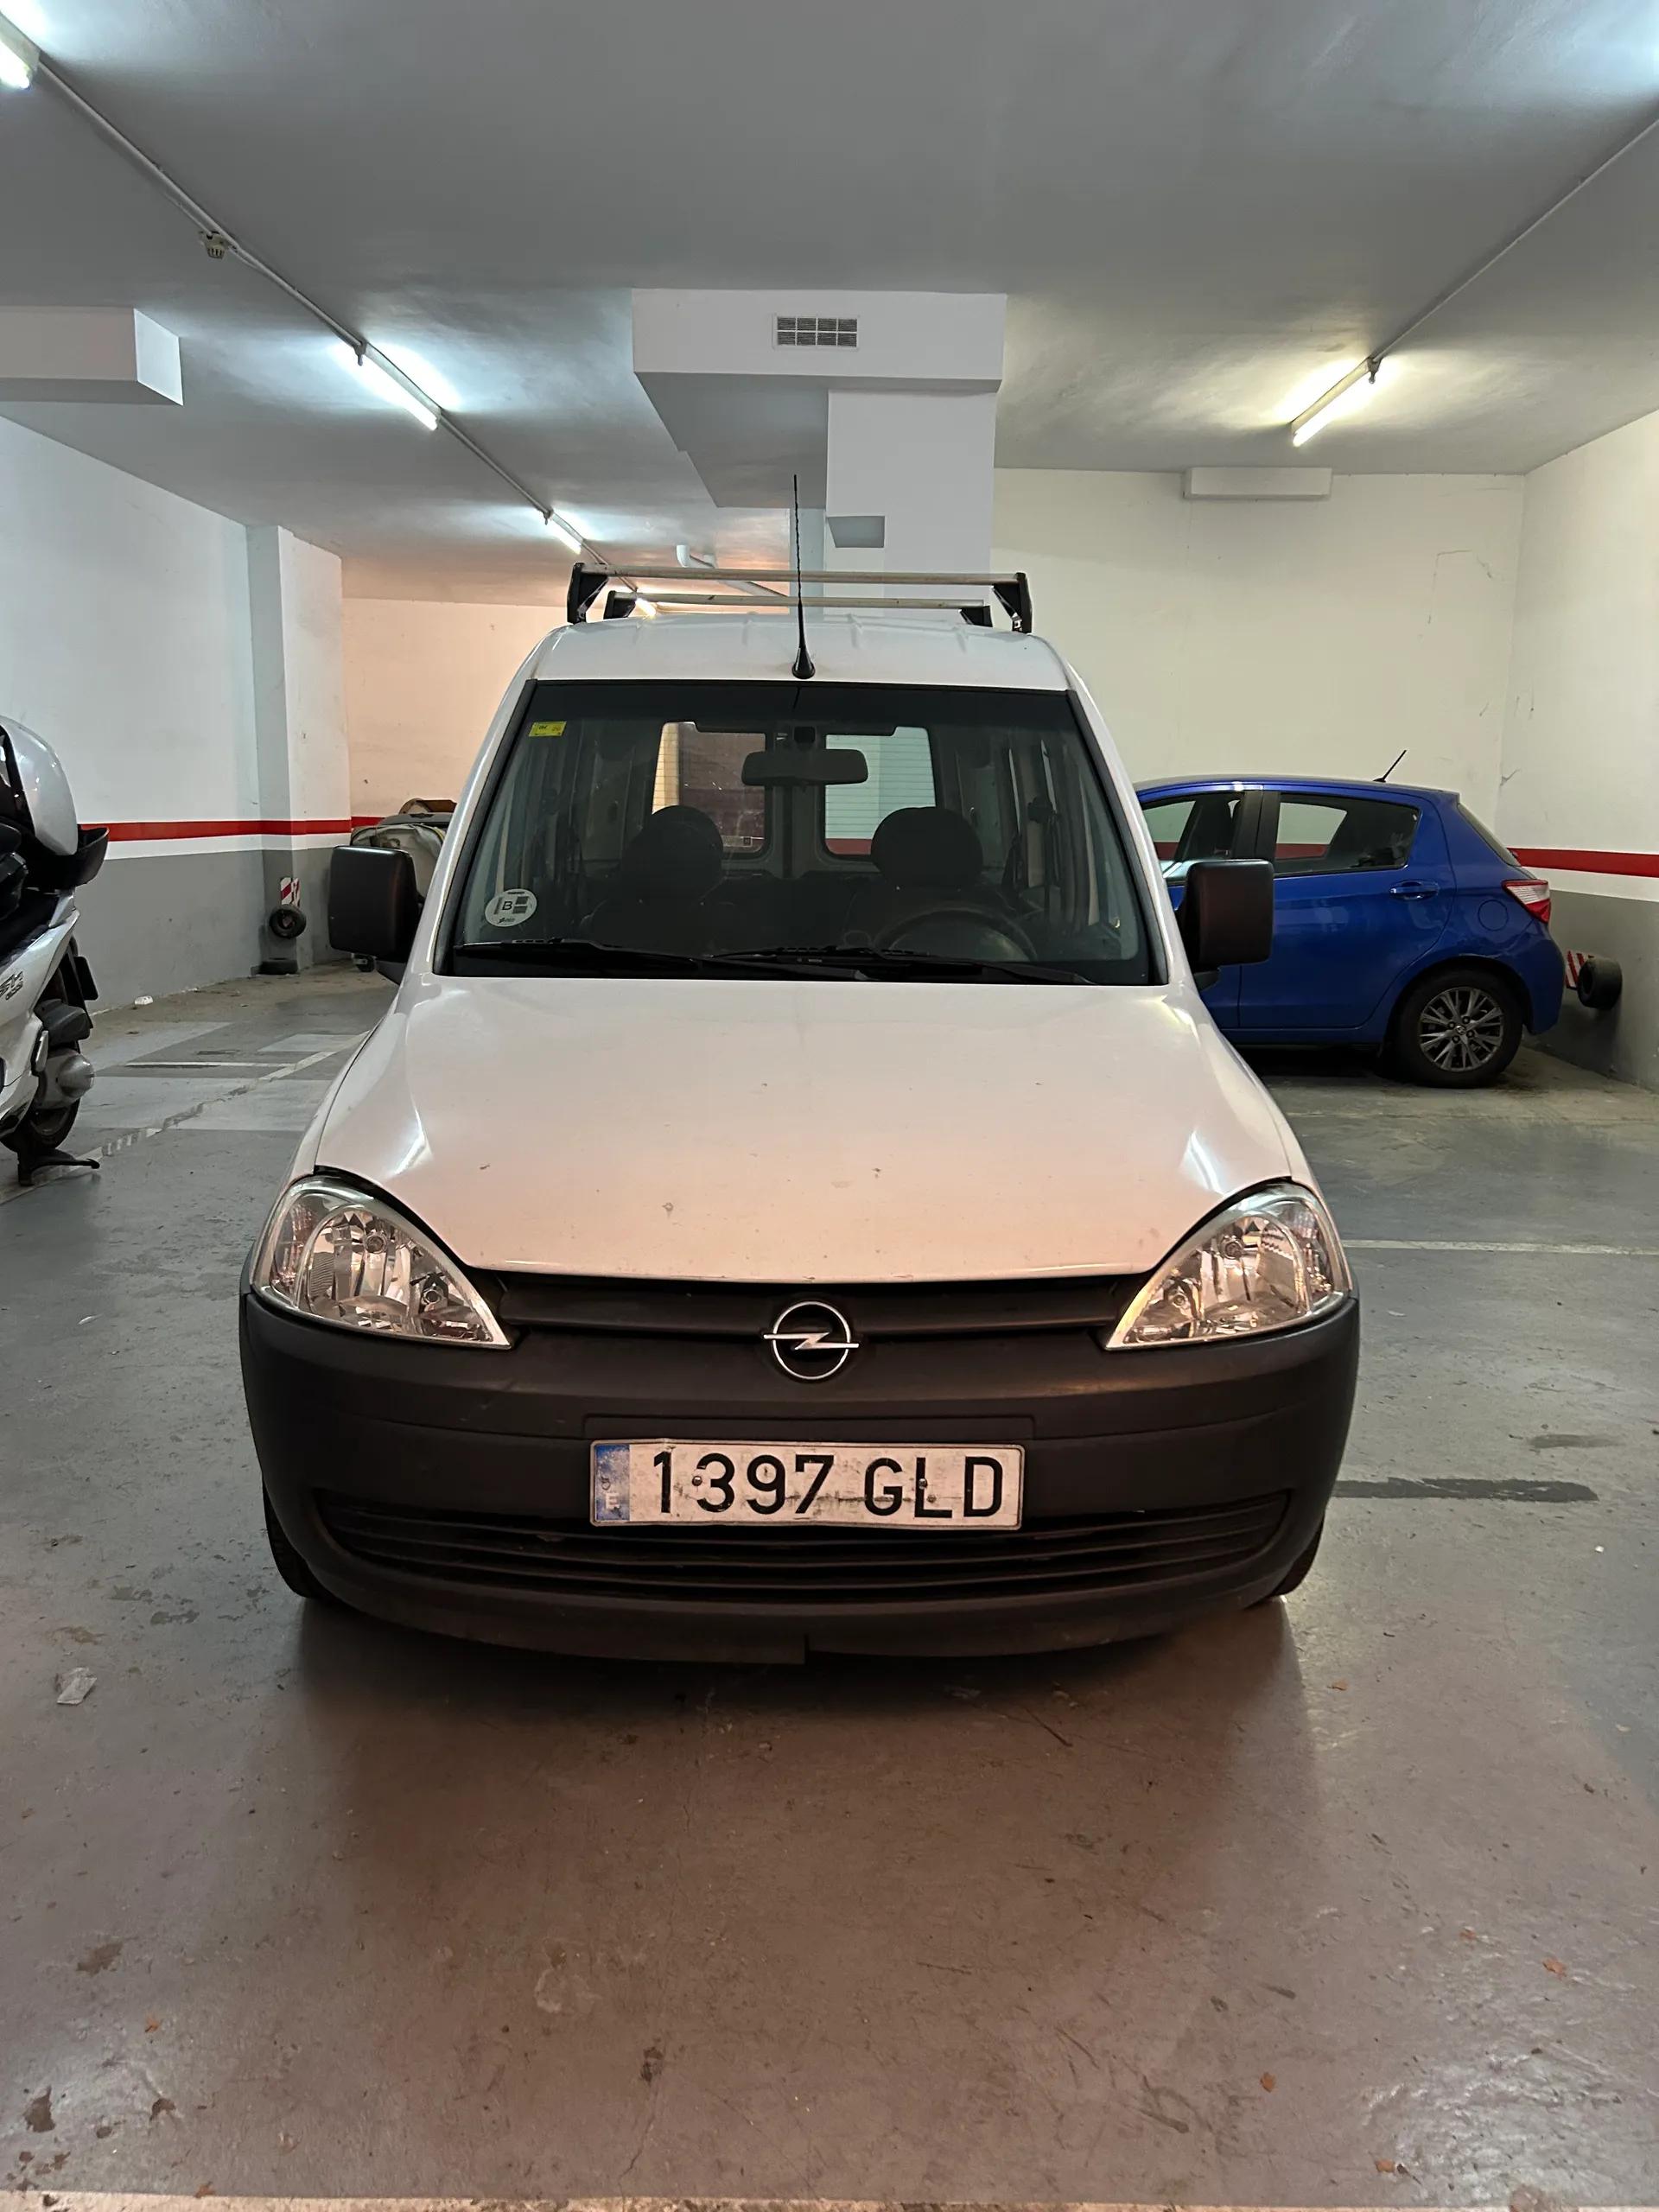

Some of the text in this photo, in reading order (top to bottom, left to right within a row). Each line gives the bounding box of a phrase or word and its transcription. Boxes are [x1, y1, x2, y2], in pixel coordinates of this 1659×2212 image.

[502, 900, 512, 911] B
[653, 1452, 1003, 1519] 1397 GLD
